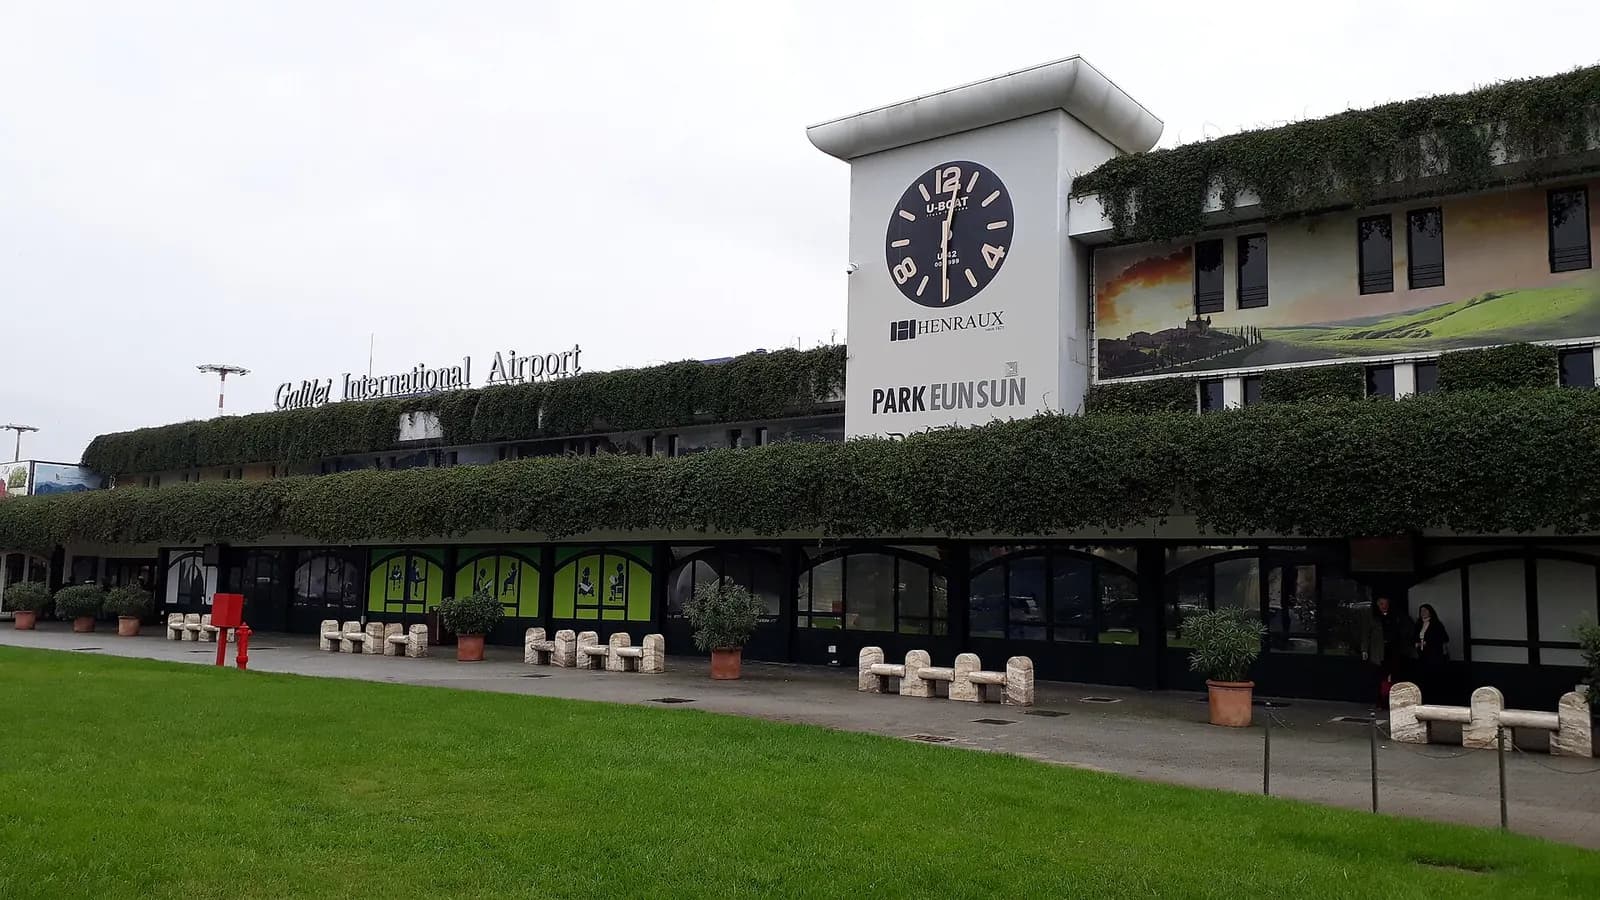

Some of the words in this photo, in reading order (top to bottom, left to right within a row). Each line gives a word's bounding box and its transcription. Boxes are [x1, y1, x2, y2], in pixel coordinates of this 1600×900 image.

[935, 166, 962, 194] 12
[926, 196, 969, 213] U-BOAT
[981, 243, 1006, 269] 4
[893, 257, 917, 285] 8
[917, 310, 1005, 335] HENRAUX
[273, 378, 332, 409] Galilei
[340, 355, 471, 401] International
[486, 343, 582, 383] Airport
[872, 385, 926, 415] PARK
[930, 377, 1026, 411] EUNSUN
